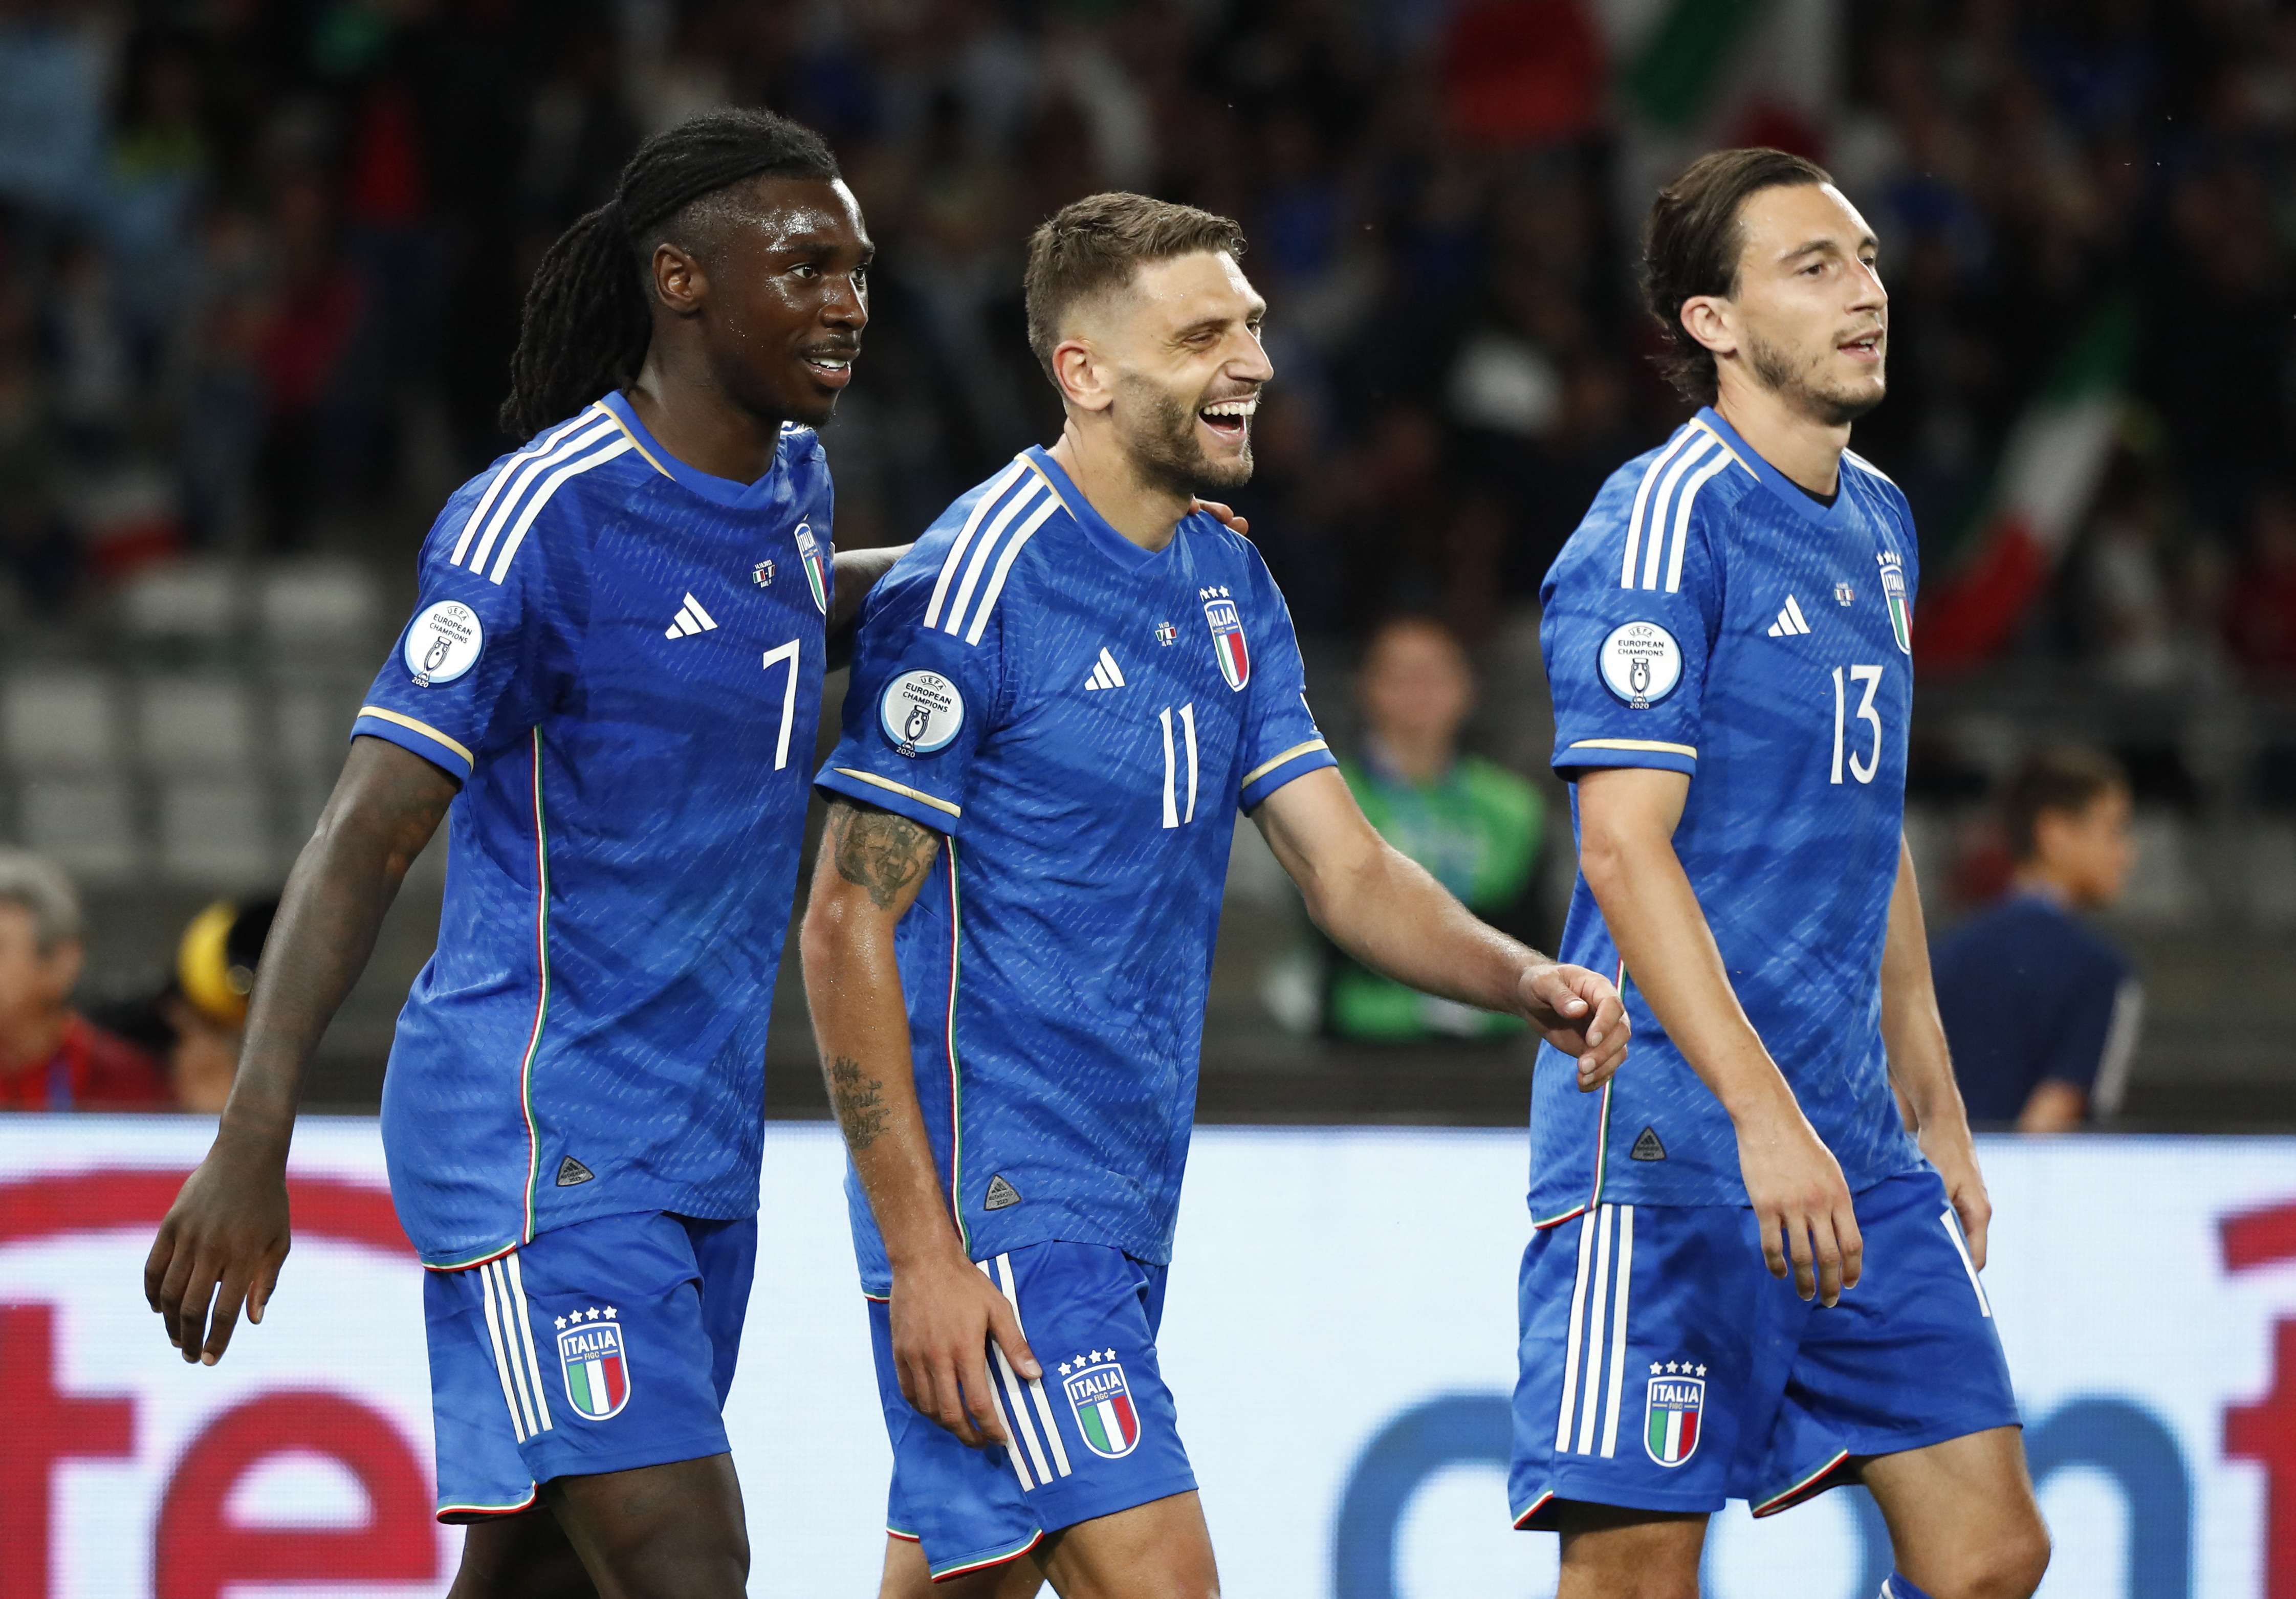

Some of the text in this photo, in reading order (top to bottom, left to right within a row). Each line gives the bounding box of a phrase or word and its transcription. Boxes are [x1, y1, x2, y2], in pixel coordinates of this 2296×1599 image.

[448, 608, 467, 621] UEFA
[1208, 607, 1236, 627] ALIA
[430, 623, 468, 644] CHAMPIONS
[433, 614, 472, 636] EUROPEAN
[1630, 628, 1652, 637] UEFA
[1619, 640, 1664, 648] EUROPEAN
[411, 676, 429, 688] 2020
[921, 677, 944, 690] UEFA
[903, 691, 948, 713] CHAMPIONS
[906, 683, 952, 705] EUROPEAN
[763, 638, 800, 771] 7
[1830, 665, 1883, 784] 13
[896, 747, 915, 758] 2020
[1159, 702, 1198, 829] 11
[563, 1330, 617, 1356] ITALIA
[584, 1351, 600, 1361] FIGC
[1070, 1371, 1122, 1400] ITALIA
[1652, 1384, 1699, 1403] ITALIA
[1094, 1392, 1108, 1401] FIGC
